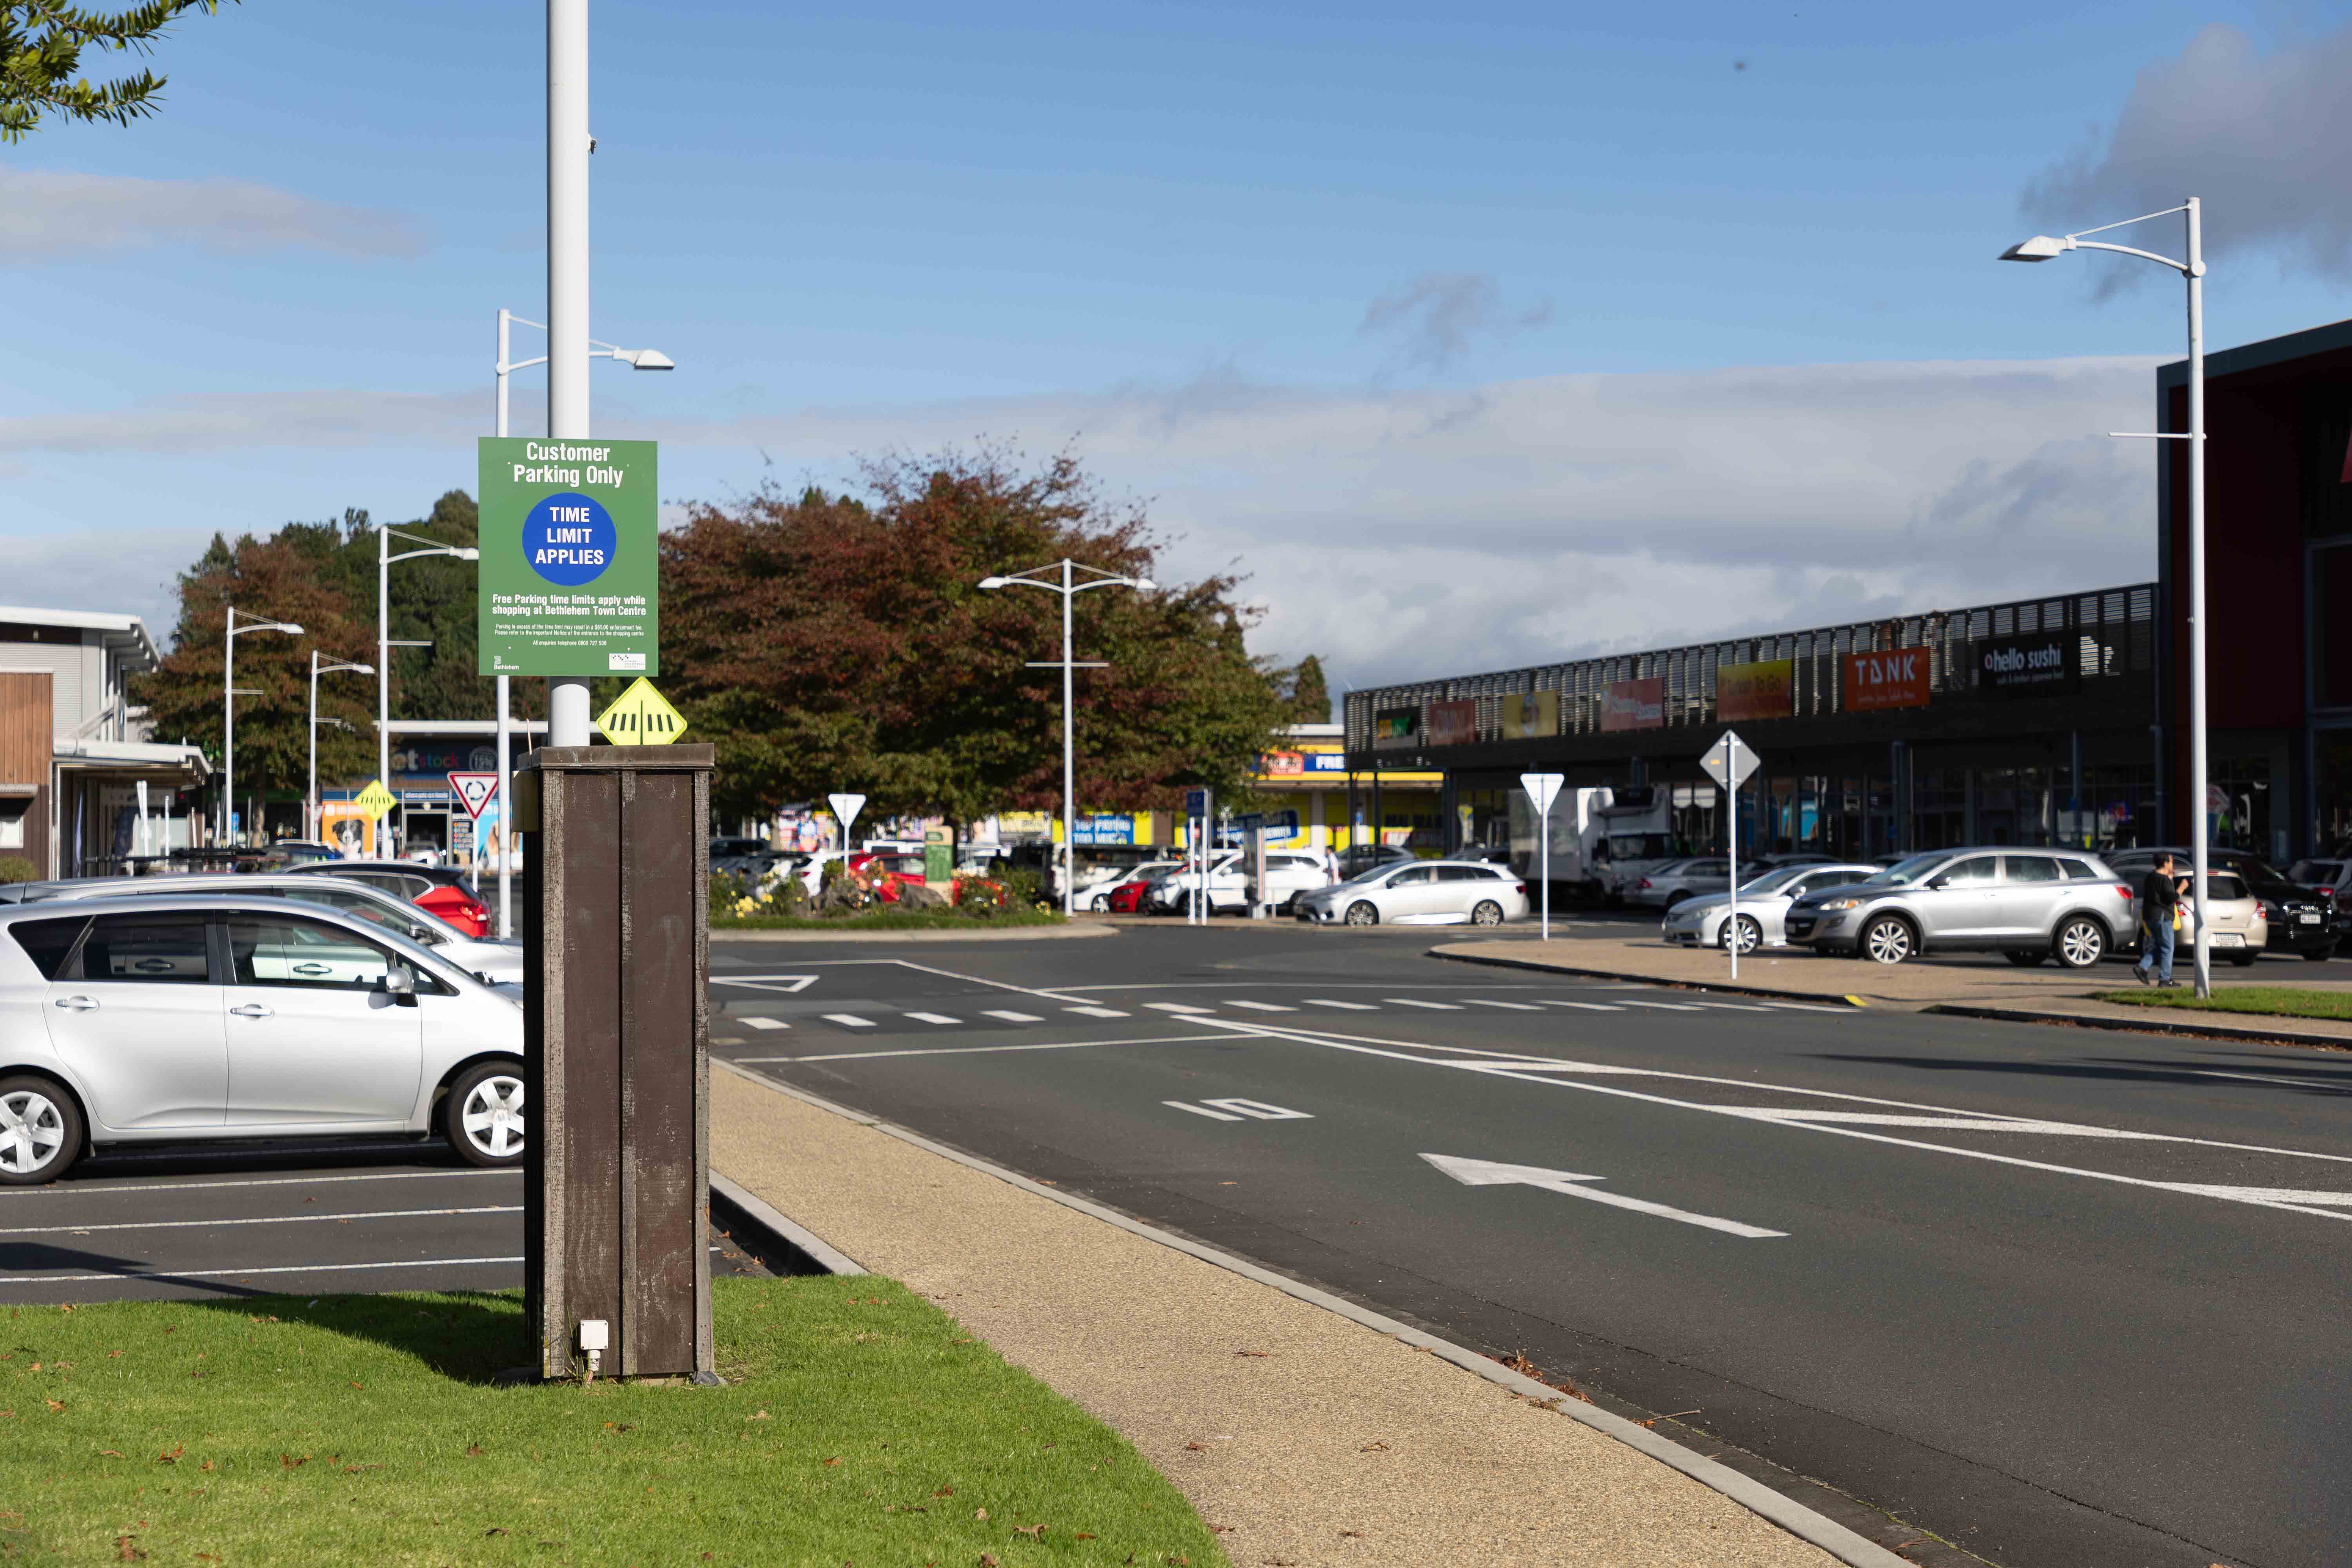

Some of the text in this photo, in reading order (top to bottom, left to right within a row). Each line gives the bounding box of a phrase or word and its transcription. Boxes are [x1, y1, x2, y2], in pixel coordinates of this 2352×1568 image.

[526, 442, 610, 461] Customer
[514, 464, 624, 488] Parking Only
[549, 507, 590, 522] TIME
[547, 528, 592, 543] LIMIT
[535, 549, 604, 565] APPLIES
[493, 594, 646, 606] Free Parking time limits apply while
[492, 605, 646, 617] shopping at Bethlehem Town Centre
[1994, 640, 2062, 672] hello sushi
[1855, 653, 1916, 686] TANK
[1095, 833, 1127, 844] MUC
[1161, 1098, 1316, 1121] 10
